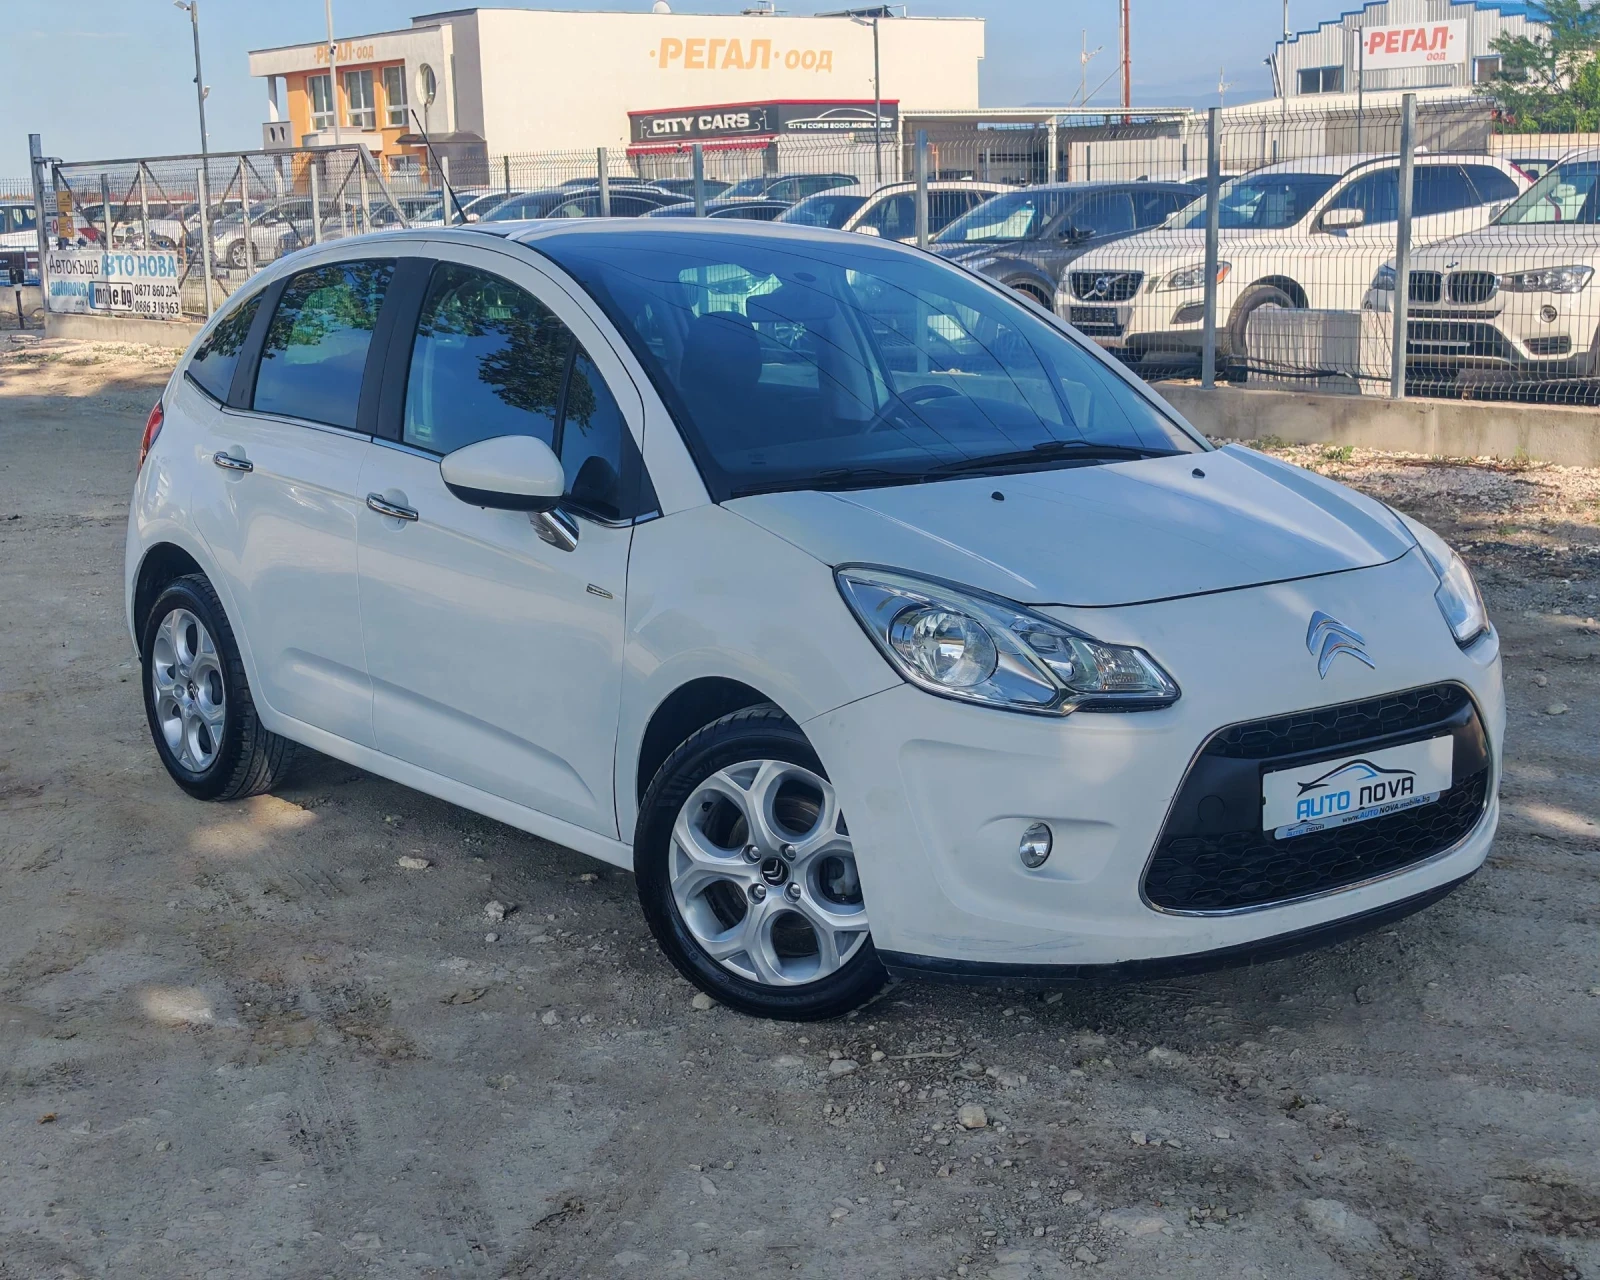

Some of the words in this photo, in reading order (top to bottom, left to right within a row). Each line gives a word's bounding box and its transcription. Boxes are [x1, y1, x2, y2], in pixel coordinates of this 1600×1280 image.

[316, 41, 353, 64] РЕАЛ
[652, 116, 694, 134] CITY
[698, 113, 750, 130] CARS
[138, 255, 177, 277] НОВА
[134, 284, 151, 297] 0877
[1297, 791, 1350, 820] AUTO
[1359, 776, 1414, 805] NOVA
